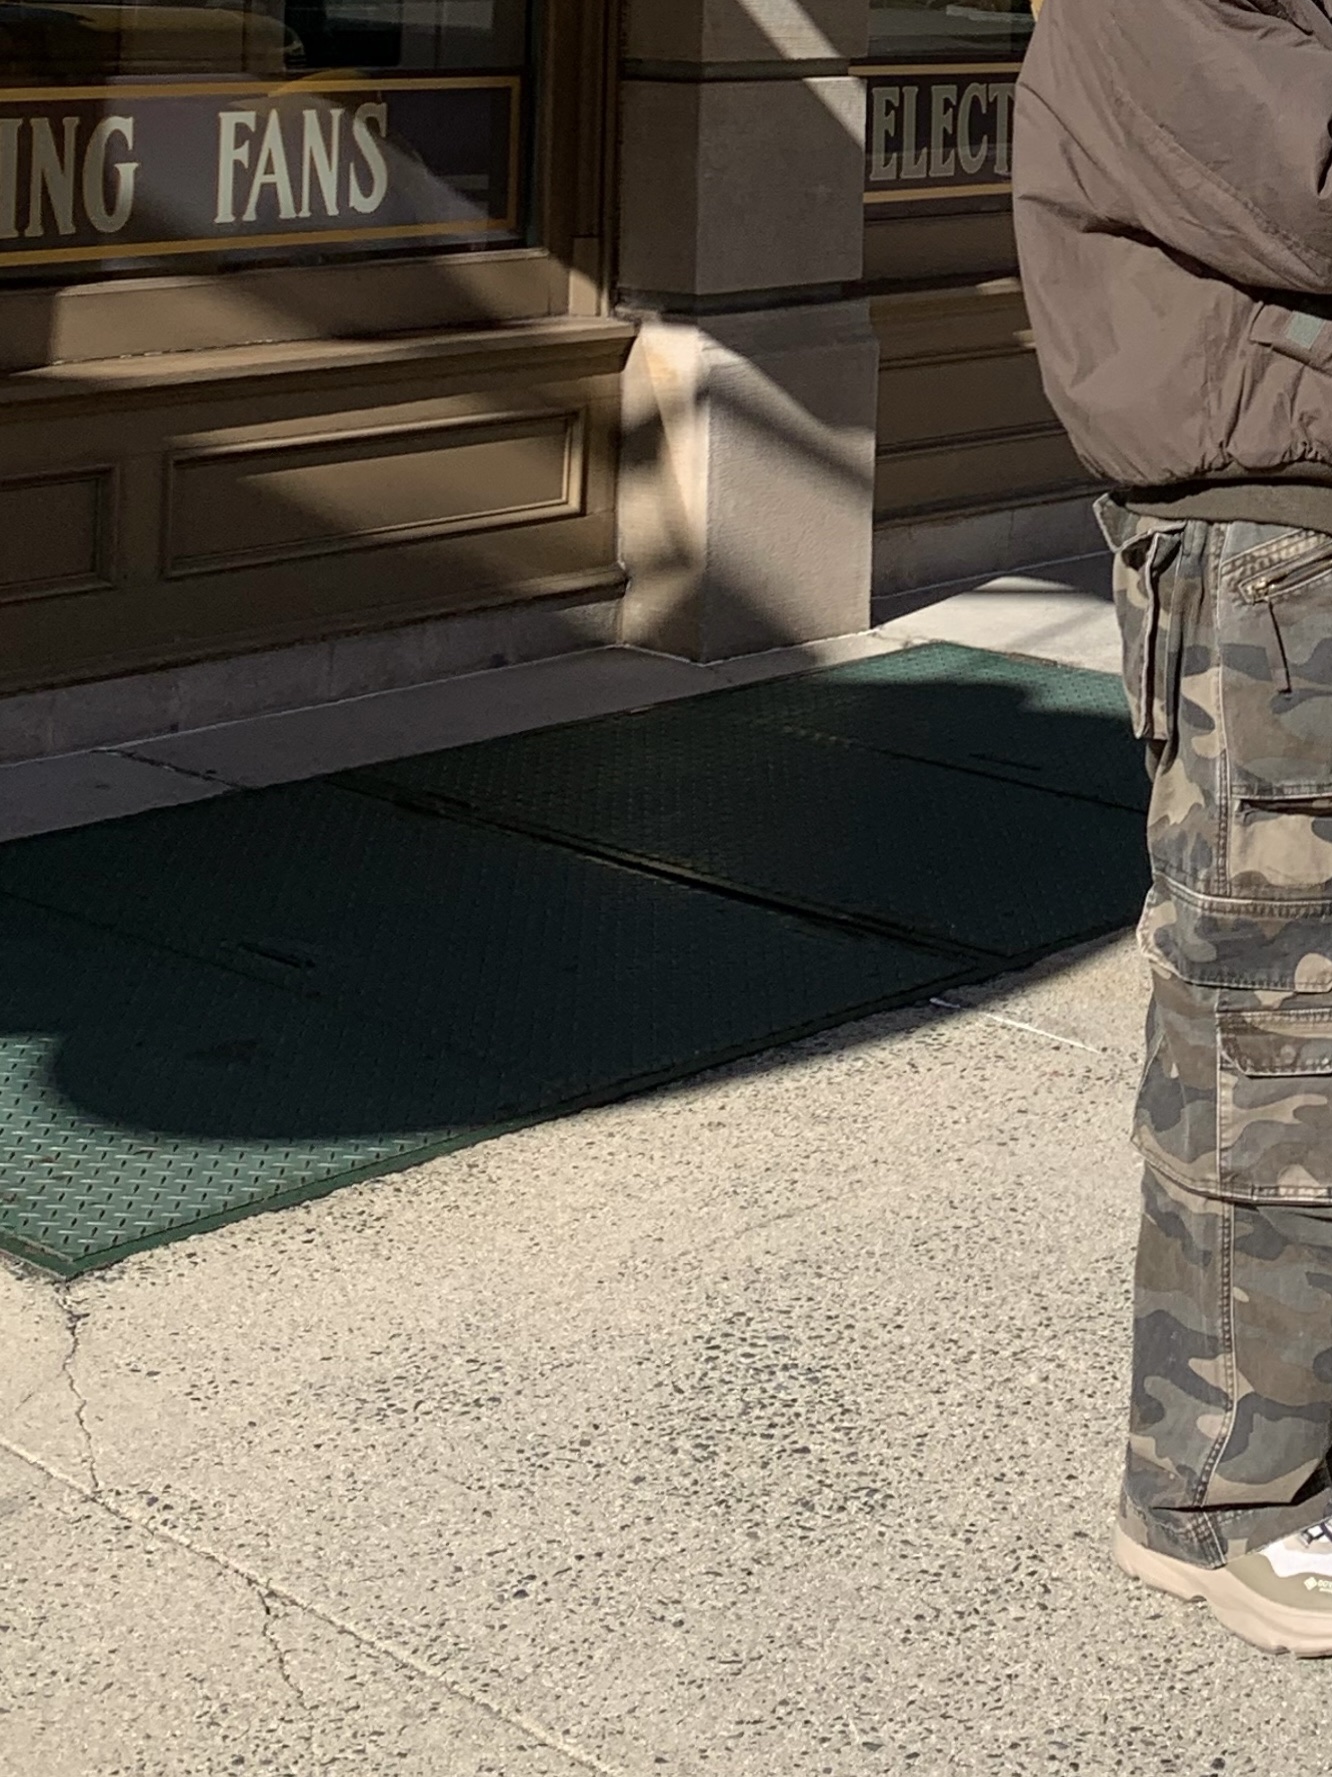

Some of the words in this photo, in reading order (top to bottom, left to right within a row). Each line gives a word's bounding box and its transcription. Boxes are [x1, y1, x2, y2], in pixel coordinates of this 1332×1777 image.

[0, 116, 138, 238] ING
[214, 102, 388, 224] FANS
[869, 82, 1016, 181] ELECT
